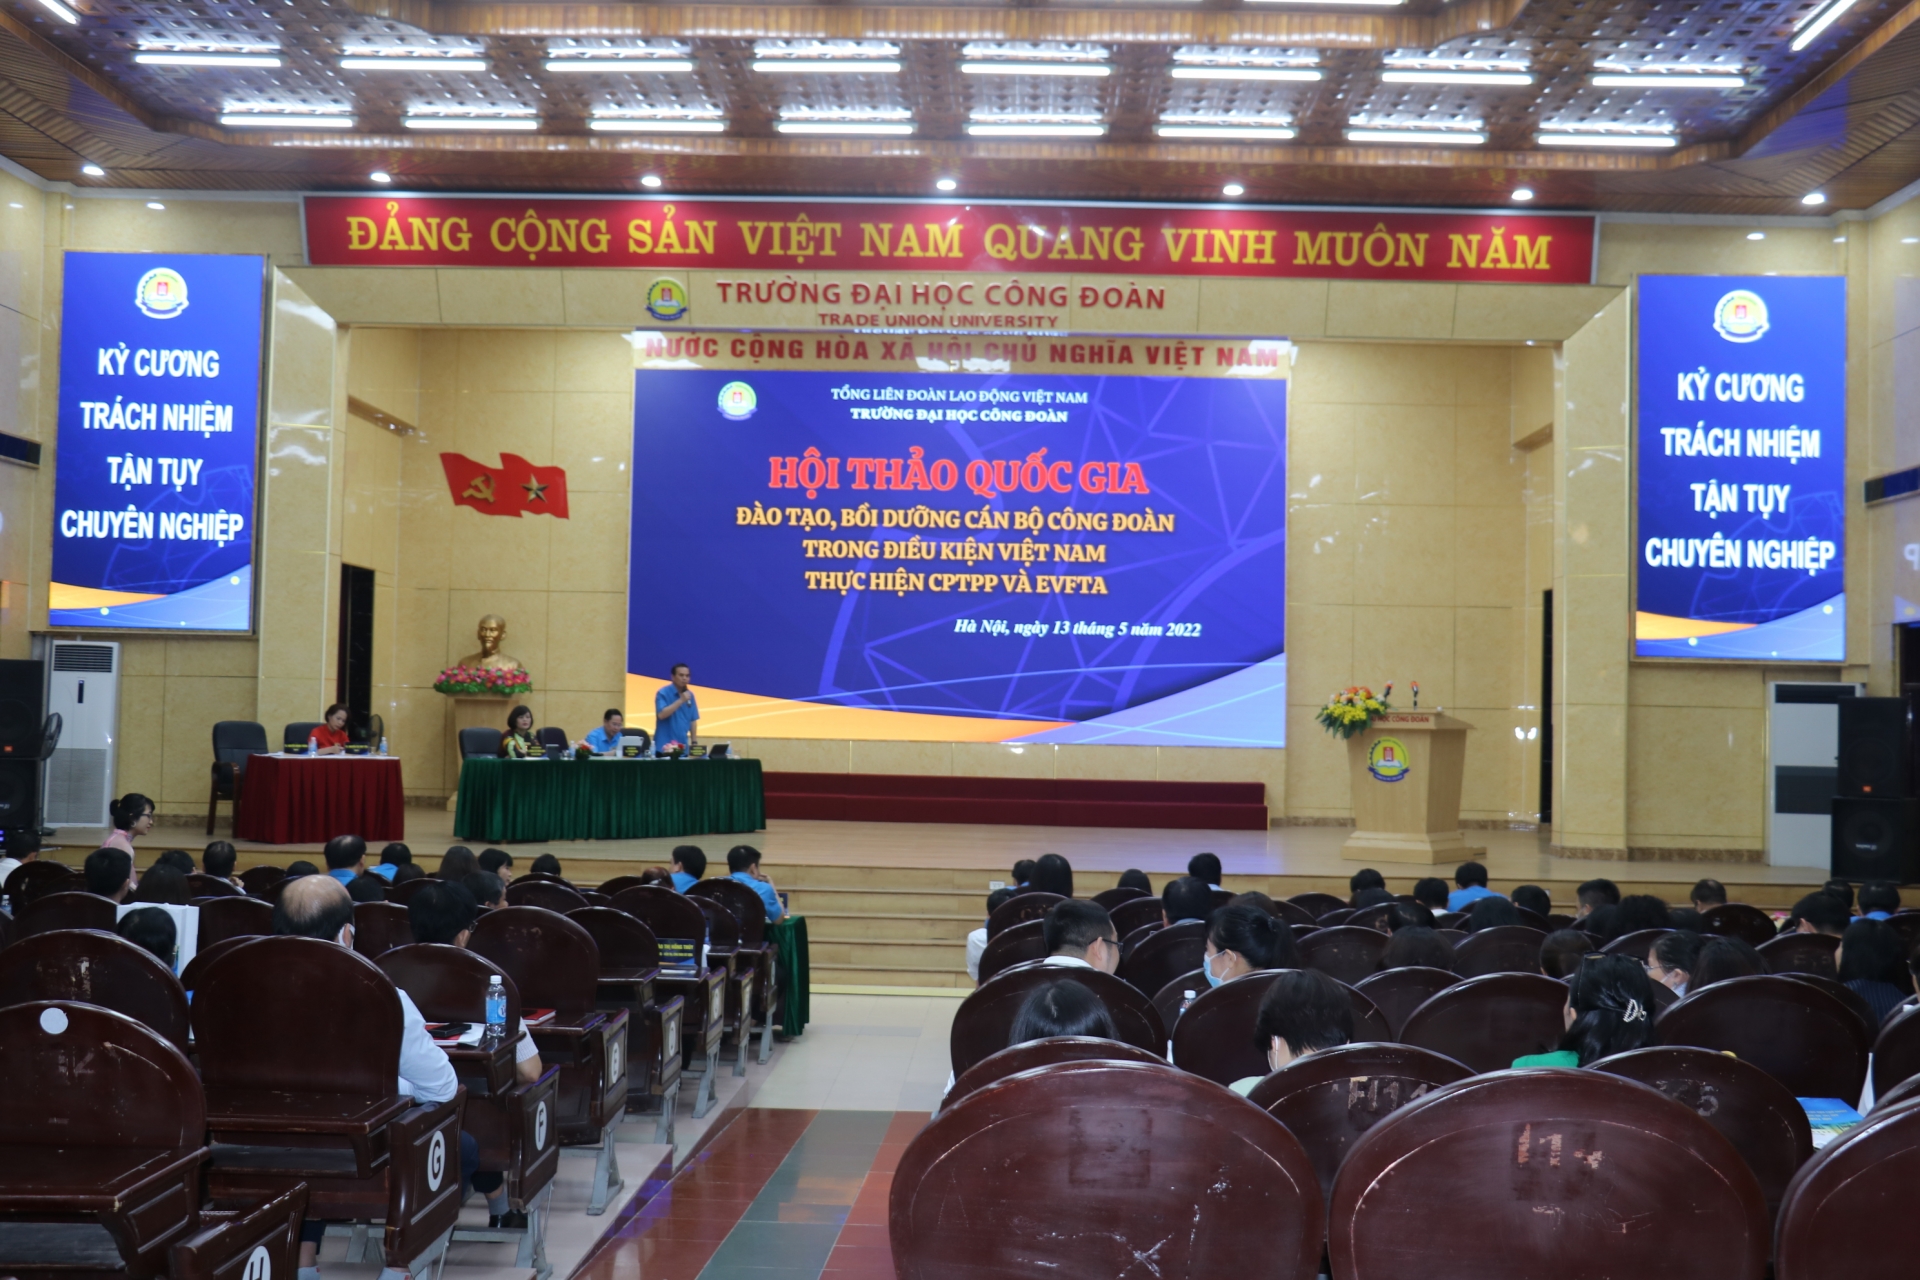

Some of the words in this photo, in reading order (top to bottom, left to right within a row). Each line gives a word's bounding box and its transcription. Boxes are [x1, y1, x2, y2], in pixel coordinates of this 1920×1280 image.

[347, 201, 472, 252] ĐẢNG
[490, 209, 611, 261] CỘNG
[628, 204, 717, 254] SẢN
[738, 213, 842, 264] VIỆT
[860, 223, 964, 258] NAM
[984, 223, 1145, 262] QUANG
[1161, 228, 1277, 264] VINH
[1293, 222, 1429, 268] MUÔN
[1446, 226, 1552, 270] NĂM
[716, 275, 841, 305] TRƯỜNG
[851, 283, 901, 311] ĐẠI
[912, 283, 974, 311] HỌC
[985, 279, 1068, 308] CÔNG
[1079, 282, 1165, 310] ĐOÀN
[819, 313, 879, 327] TRADE
[885, 314, 944, 327] UNION
[950, 314, 1058, 328] UNIVERSITY
[97, 341, 130, 376] KỶ
[134, 348, 220, 378] CƯƠNG
[730, 332, 804, 364] CỘNG
[816, 334, 869, 360] HÒA
[881, 337, 915, 361] XÃ
[1050, 339, 1133, 365] NGHĨA
[1146, 341, 1204, 370] VIỆT
[1217, 346, 1278, 367] NAM
[831, 384, 870, 401] TỔNG
[873, 386, 904, 401] LIÊN
[907, 386, 946, 402] ĐOÀN
[949, 390, 976, 402] LAO
[979, 388, 1020, 405] ĐỘNG
[1022, 388, 1054, 406] VIỆT
[1056, 392, 1087, 404] NAM
[1677, 366, 1710, 401] KỶ
[1715, 372, 1805, 403] CƯƠNG
[80, 395, 157, 430] TRÁCH
[162, 400, 233, 439] NHIỆM
[850, 406, 913, 421] TRƯỜNG
[917, 408, 943, 423] ĐẠI
[946, 409, 978, 424] HỌC
[980, 407, 1021, 422] CÔNG
[1025, 407, 1068, 423] ĐOÀN
[1660, 420, 1740, 457] TRÁCH
[1747, 425, 1820, 464] NHIỆM
[107, 452, 153, 491] TẬN
[158, 457, 204, 493] TỤY
[768, 446, 840, 499] HỘI
[847, 446, 958, 491] THẢO
[965, 447, 1073, 498] QUỐC
[1079, 462, 1149, 494] GIA
[1690, 478, 1738, 519] TẬN
[1743, 484, 1791, 520] TỤY
[61, 504, 154, 539] CHUYÊN
[159, 509, 244, 548] NGHIỆP
[736, 501, 782, 526] ĐÀO
[785, 507, 837, 532] TẠO,
[840, 502, 878, 527] BỒI
[882, 504, 960, 529] DƯỠNG
[964, 504, 1010, 529] CÁN
[1014, 506, 1044, 535] BỘ
[1047, 506, 1108, 531] CÔNG
[1112, 507, 1175, 532] ĐOÀN
[803, 539, 880, 559] TRONG
[883, 535, 936, 560] ĐIỀU
[940, 537, 994, 566] KIỆN
[997, 538, 1050, 567] VIỆT
[1053, 544, 1106, 562] NAM
[1645, 531, 1741, 568] CHUYÊN
[1747, 535, 1836, 577] NGHIỆP
[805, 570, 866, 596] THỰC
[869, 567, 925, 597] HIỆN
[928, 573, 999, 592] CPTPP
[1001, 568, 1032, 593] VÀ
[1036, 575, 1108, 594] EVFTA
[954, 618, 976, 634] Hà
[980, 619, 1010, 636] Nội,
[1014, 621, 1049, 637] ngày
[1052, 620, 1070, 635] 13
[1073, 621, 1115, 638] tháng
[1118, 622, 1128, 636] 5
[1131, 623, 1162, 636] năm
[1166, 623, 1202, 638] 2022
[539, 1108, 545, 1144] F
[431, 1139, 442, 1180] G
